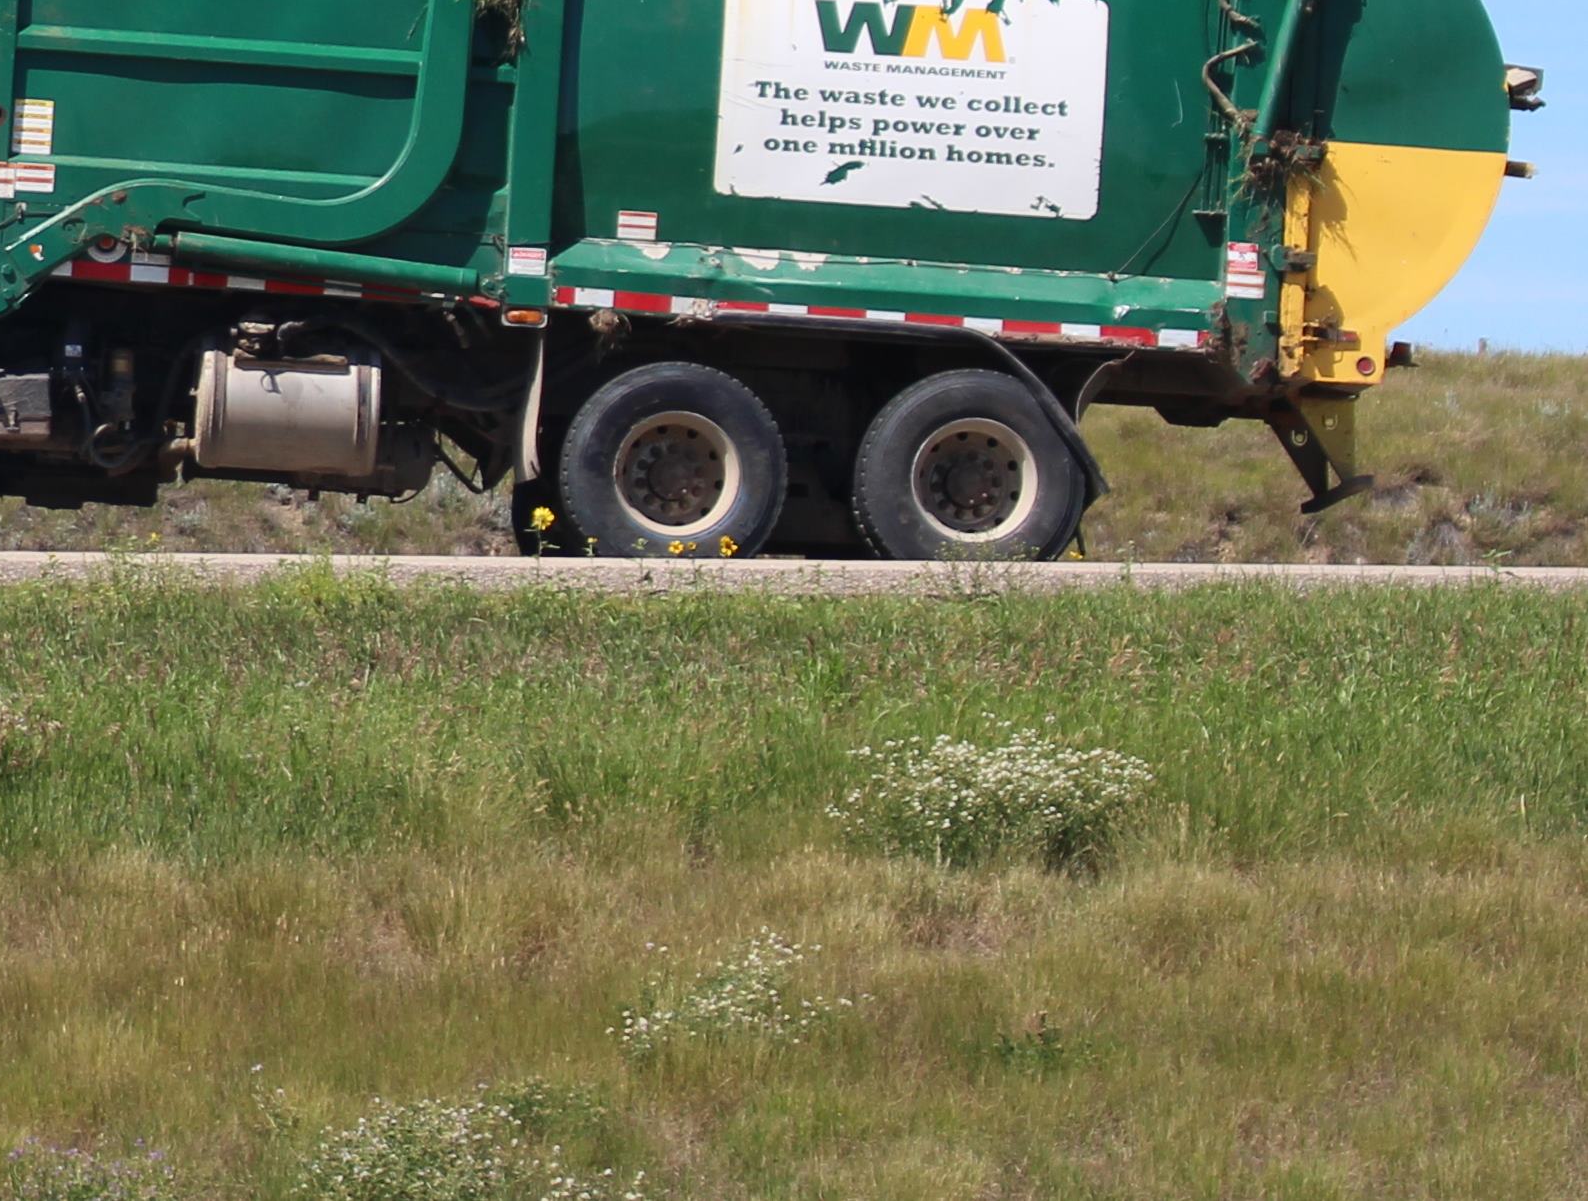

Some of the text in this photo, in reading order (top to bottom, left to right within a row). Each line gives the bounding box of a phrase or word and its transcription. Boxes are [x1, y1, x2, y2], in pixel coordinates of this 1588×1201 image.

[815, 0, 1007, 63] WM
[824, 60, 1008, 80] WASTE MANAGEMENT
[755, 80, 1069, 117] The waste we collect
[780, 108, 1041, 141] helps power over
[763, 137, 818, 153] one
[946, 144, 1056, 169] homes.
